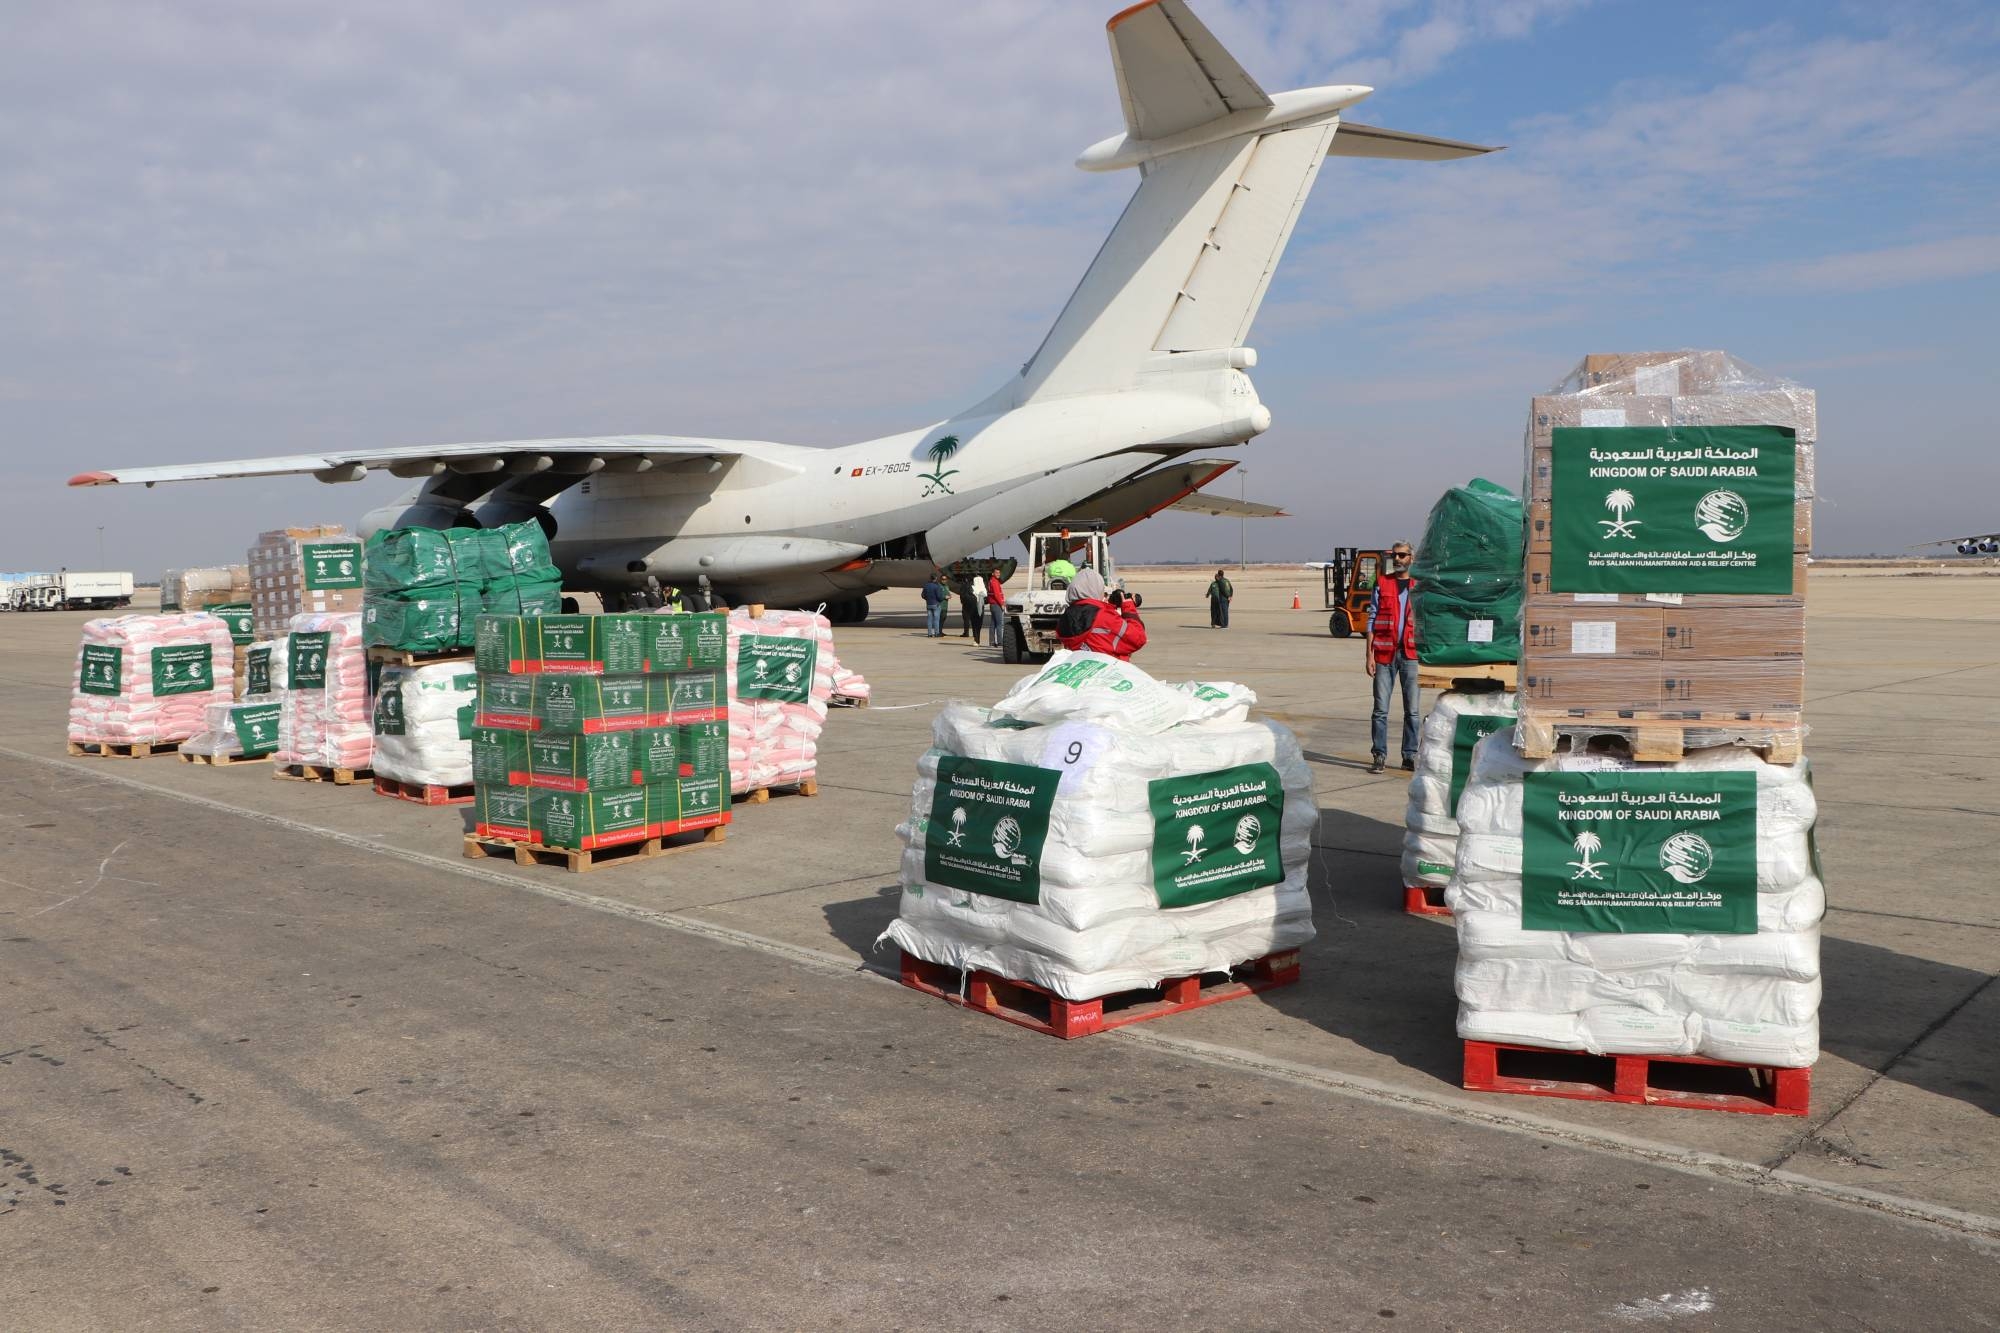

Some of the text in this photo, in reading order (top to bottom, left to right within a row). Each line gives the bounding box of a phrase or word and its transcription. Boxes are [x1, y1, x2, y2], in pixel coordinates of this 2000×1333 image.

[1589, 446, 1758, 462] المملكة العربية السعودية
[865, 462, 911, 476] EX-76005
[1589, 466, 1758, 478] KINGDOM OF SAUDI ARABIA
[1064, 741, 1083, 765] 9
[949, 789, 1031, 809] KINGDOM OF SAUDI ARABIA
[1172, 781, 1267, 806] المملكة العربية السعودية
[1558, 791, 1721, 805] المملكة العربية السعودية
[1175, 794, 1267, 819] KINGDOM OF SAUDI ARABIA
[1558, 810, 1721, 820] KINGDOM OF SAUDI ARABIA
[1603, 899, 1655, 907] HUMANITARIAN
[1696, 900, 1722, 908] CENTRE
